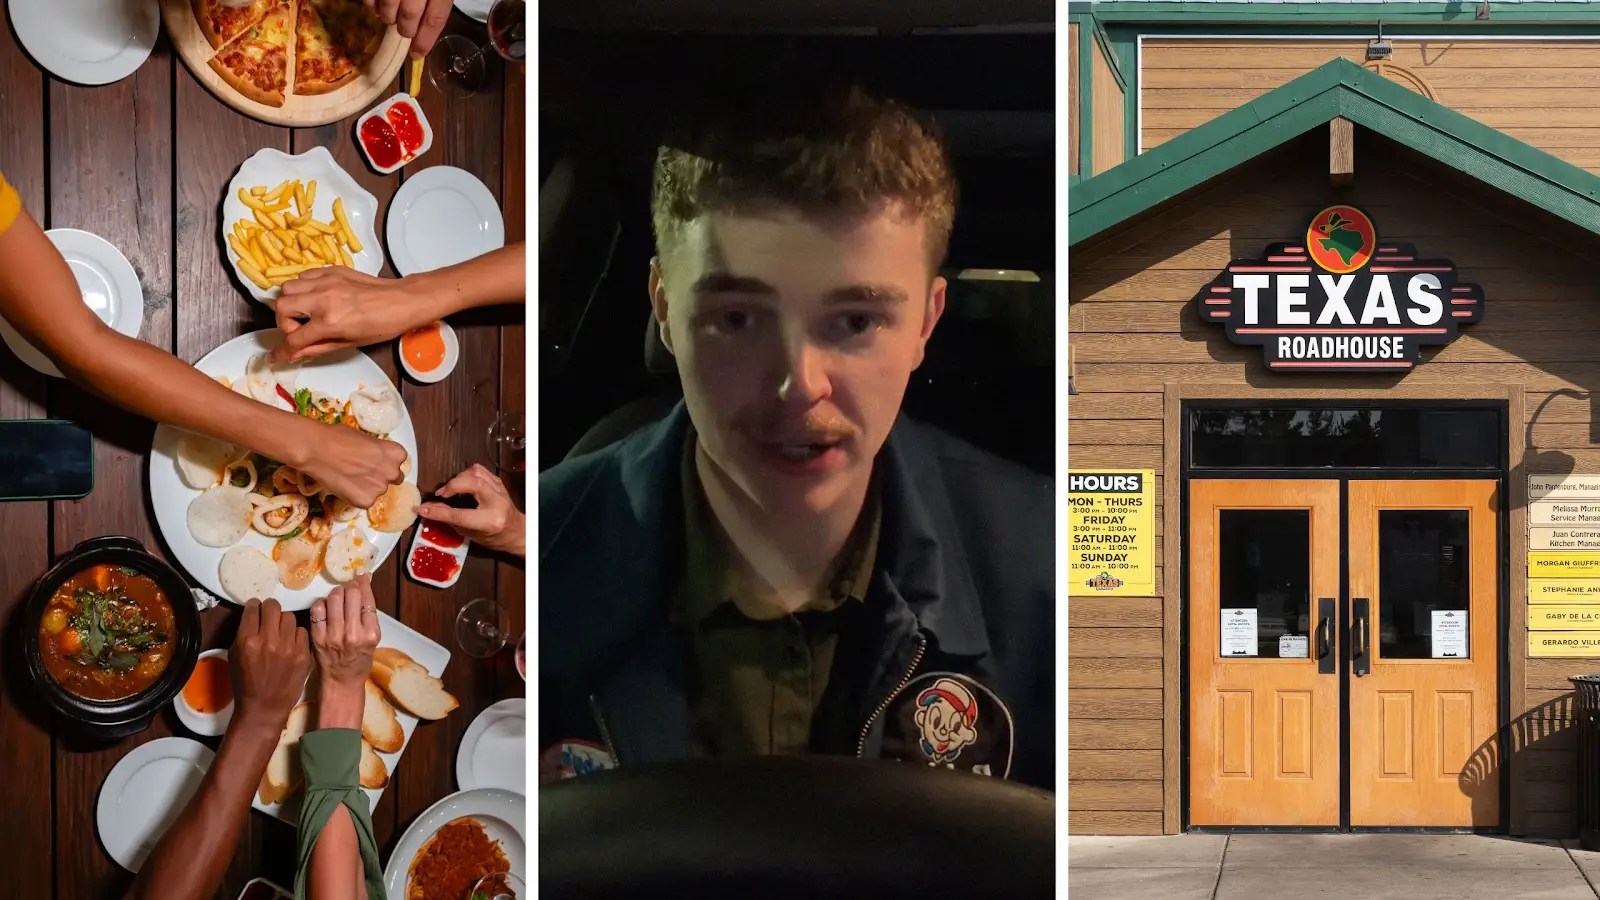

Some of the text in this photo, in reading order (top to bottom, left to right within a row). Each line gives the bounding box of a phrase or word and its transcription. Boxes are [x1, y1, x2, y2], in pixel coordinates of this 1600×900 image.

[1233, 273, 1443, 325] TEXAS
[1279, 336, 1403, 358] ROADHOUSE
[1070, 475, 1139, 490] HOURS
[1068, 498, 1093, 506] MON
[1105, 498, 1142, 506] THURS
[1084, 516, 1125, 524] FRIDAY
[1074, 535, 1136, 543] SATURDAY
